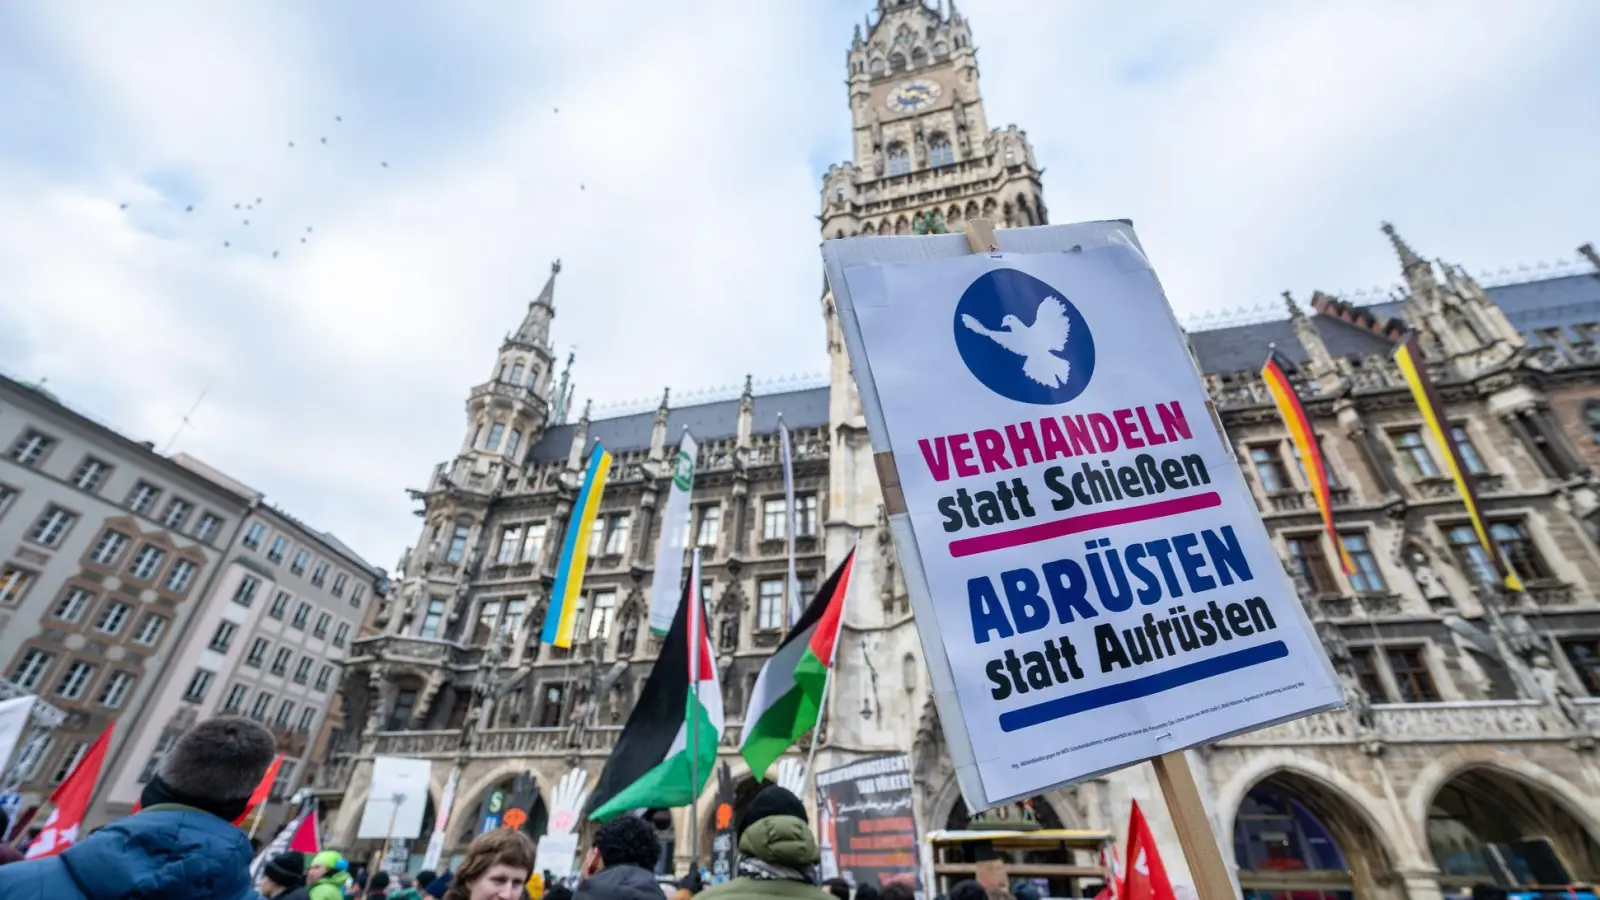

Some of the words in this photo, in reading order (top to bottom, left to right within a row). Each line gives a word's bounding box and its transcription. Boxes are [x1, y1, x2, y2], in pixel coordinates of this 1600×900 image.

[918, 401, 1193, 482] VERHANDELN
[937, 478, 1036, 532] statt
[1044, 453, 1211, 511] Schießen
[967, 525, 1254, 644] ABRÜSTEN
[986, 636, 1085, 700] statt
[1094, 595, 1277, 673] Aufrüsten
[489, 791, 503, 813] S
